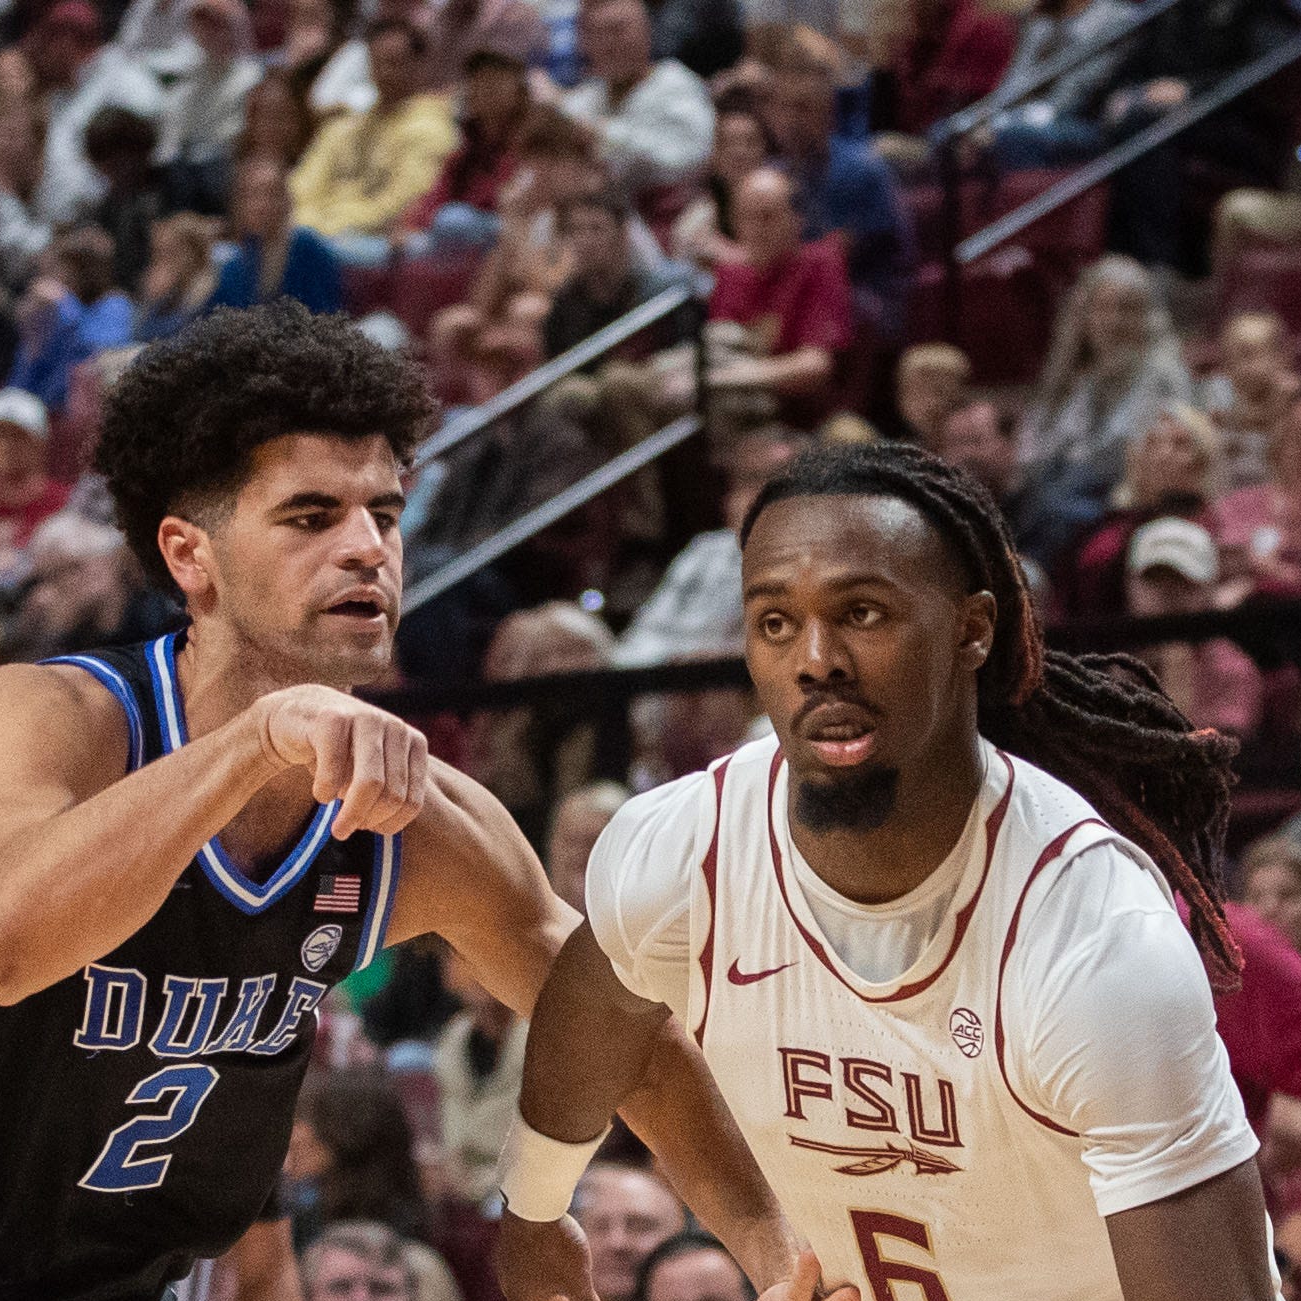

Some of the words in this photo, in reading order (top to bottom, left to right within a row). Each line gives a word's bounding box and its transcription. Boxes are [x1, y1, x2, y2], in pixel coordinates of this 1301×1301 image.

[73, 963, 327, 1058] DUKE
[953, 1023, 982, 1039] ACC
[78, 1064, 220, 1192] 2
[778, 1047, 965, 1148] FSU
